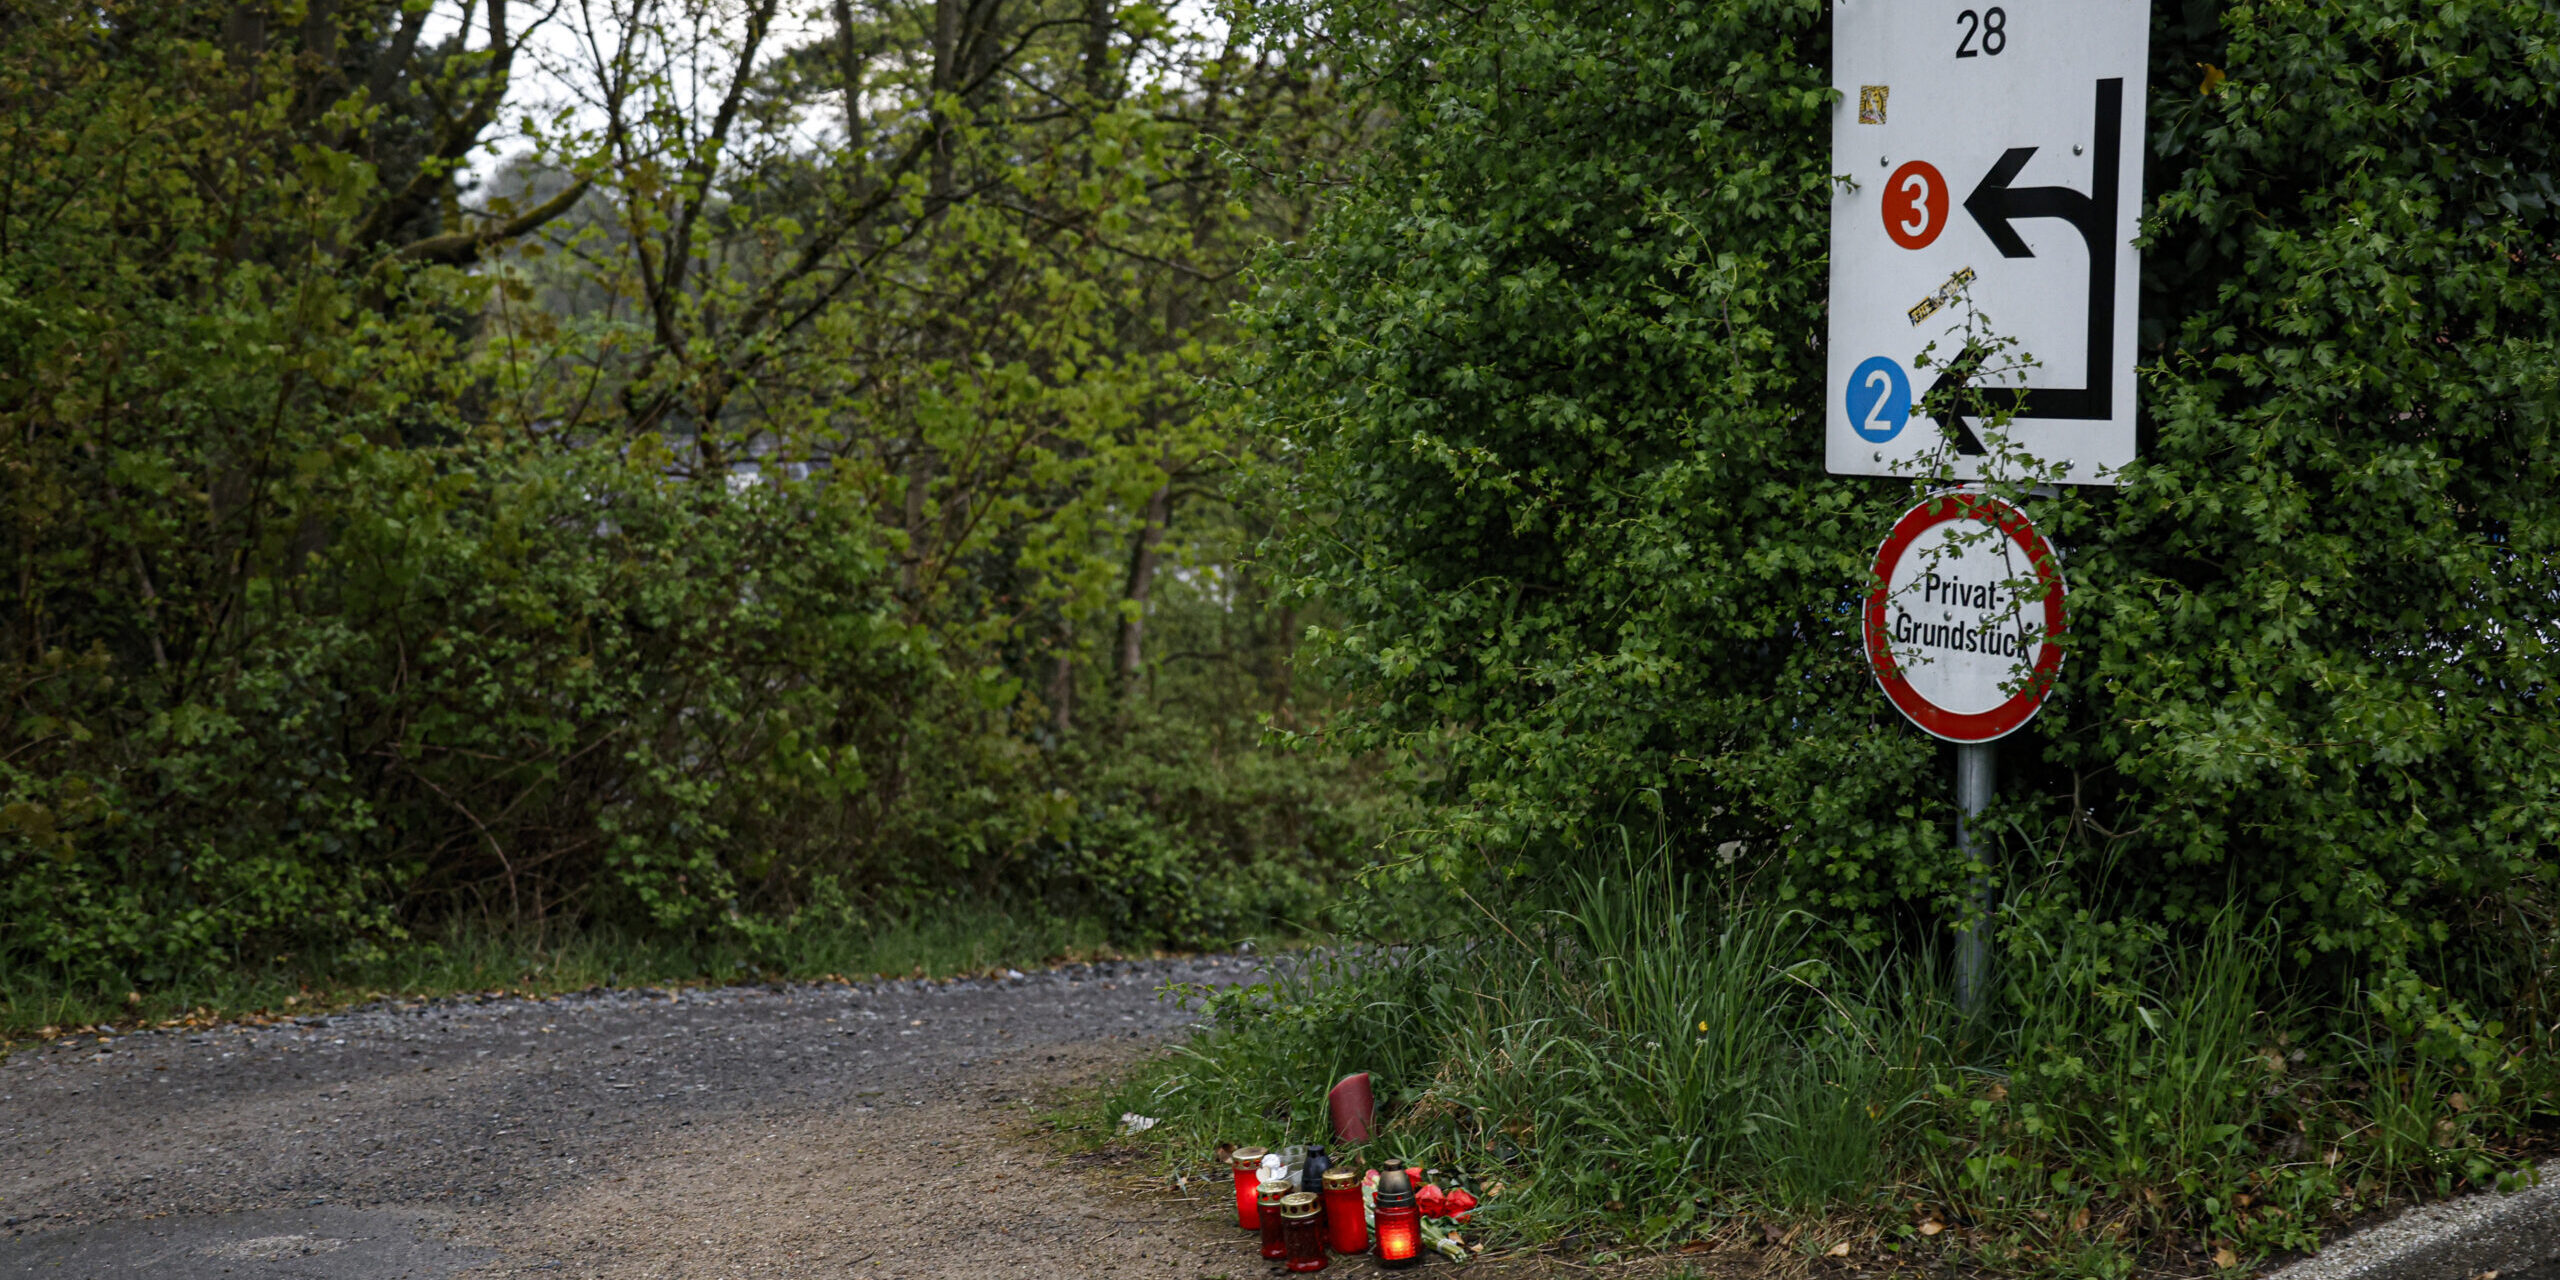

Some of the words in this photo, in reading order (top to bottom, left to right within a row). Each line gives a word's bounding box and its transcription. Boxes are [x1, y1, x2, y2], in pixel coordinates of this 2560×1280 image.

[1956, 7, 2006, 58] 28
[1901, 174, 1929, 236] 3
[1865, 370, 1892, 430] 2
[1925, 574, 2005, 609] Privat-
